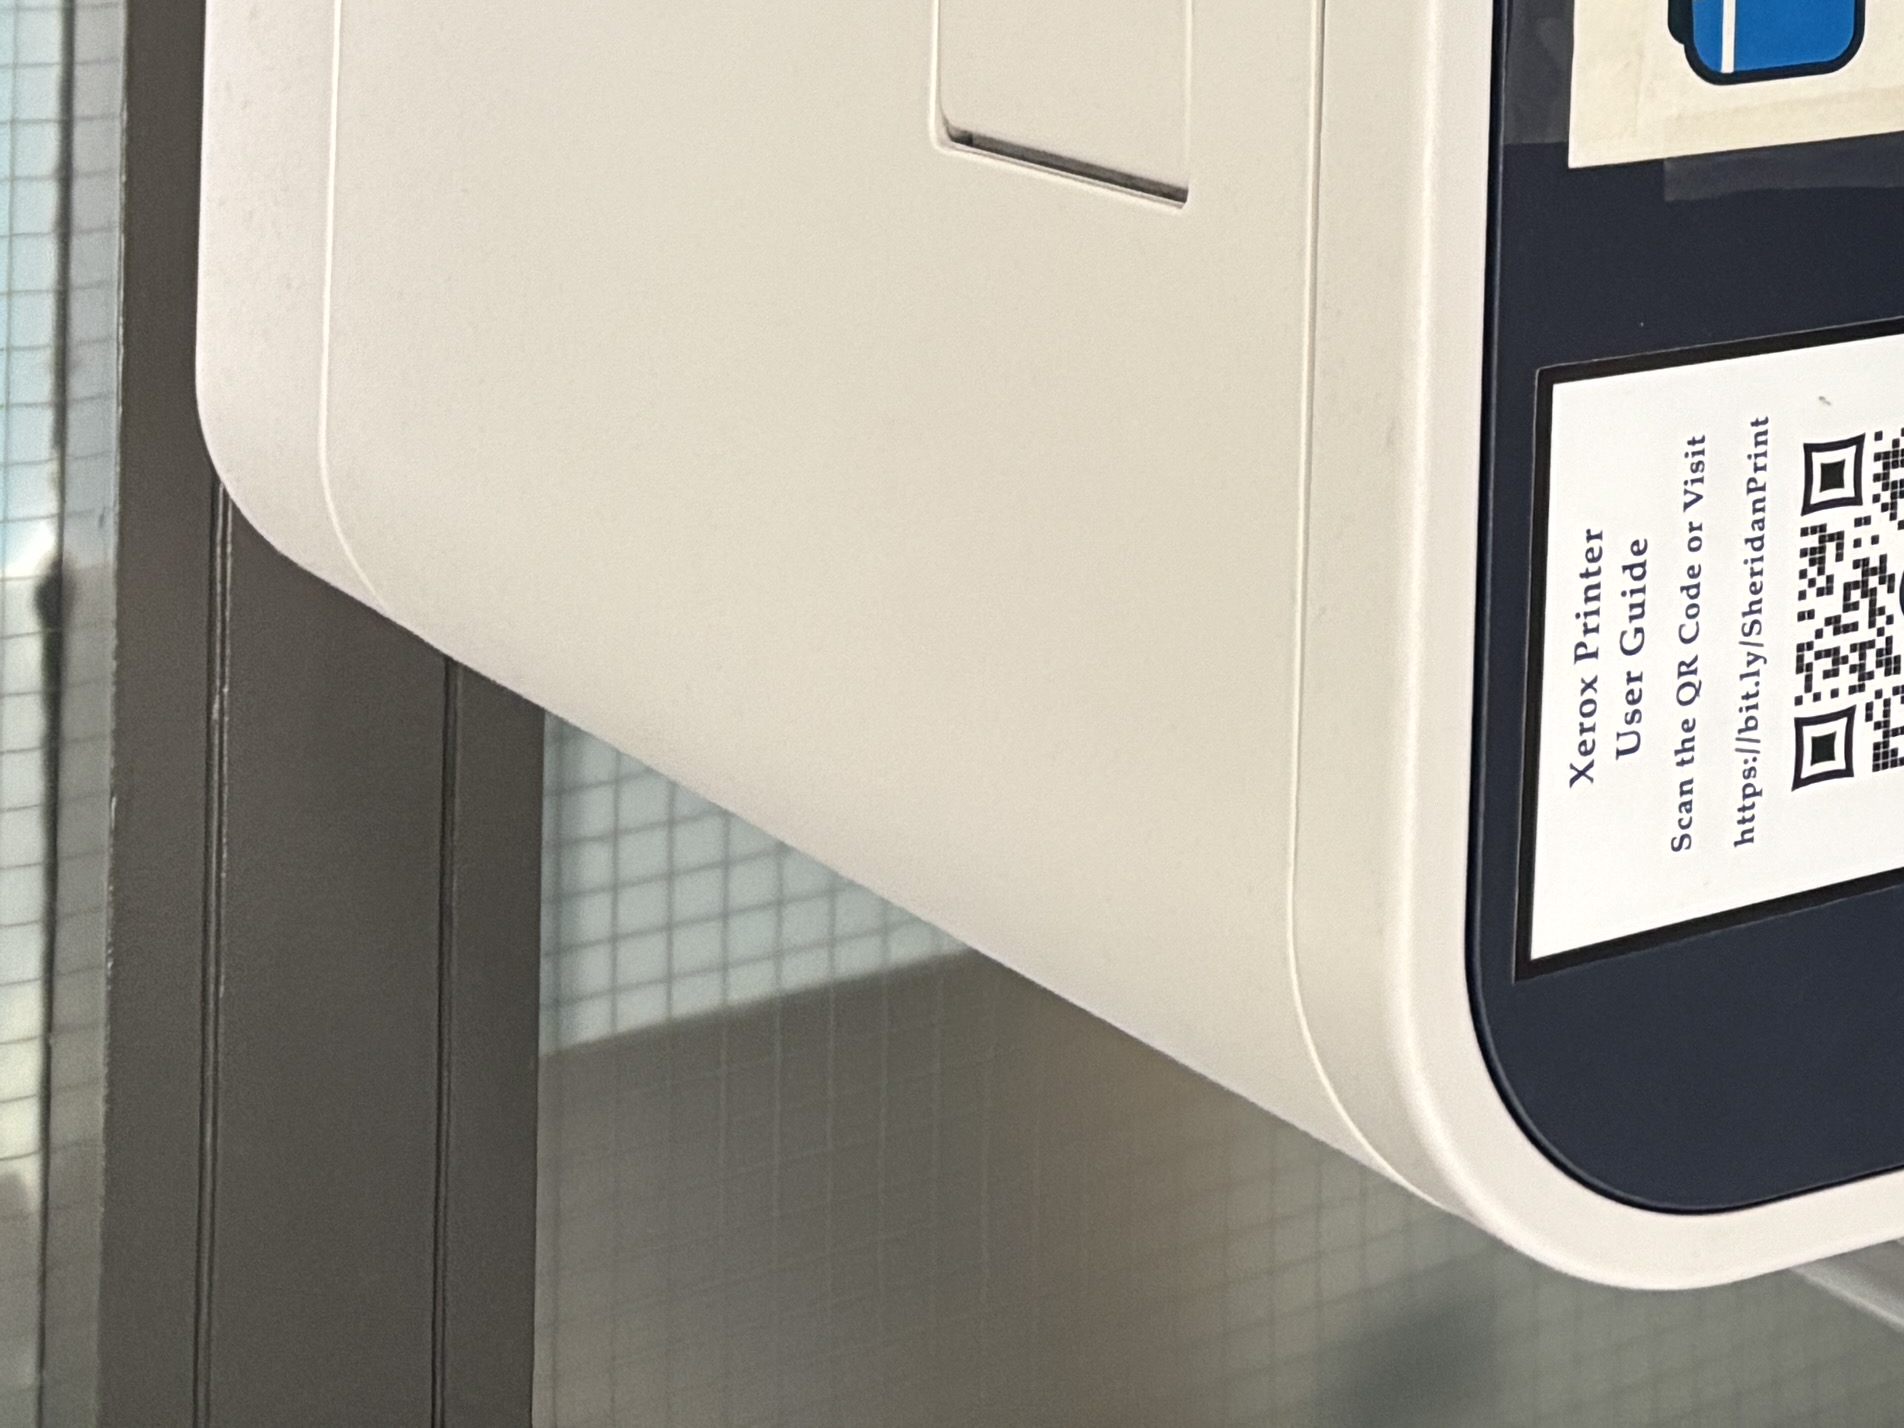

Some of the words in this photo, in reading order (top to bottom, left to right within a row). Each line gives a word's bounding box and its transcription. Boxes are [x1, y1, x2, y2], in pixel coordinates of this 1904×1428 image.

[1683, 434, 1707, 511] Visit
[1686, 522, 1705, 552] or
[1572, 527, 1605, 662] Printer
[1618, 537, 1649, 657] Guide
[1680, 562, 1703, 645] Code
[1734, 415, 1771, 847] https://bit.ly/SheridanPrint
[1616, 669, 1645, 759] User
[1677, 653, 1704, 707] QR
[1568, 676, 1598, 788] Xerox
[1673, 716, 1698, 767] the
[1671, 777, 1695, 852] Scan
